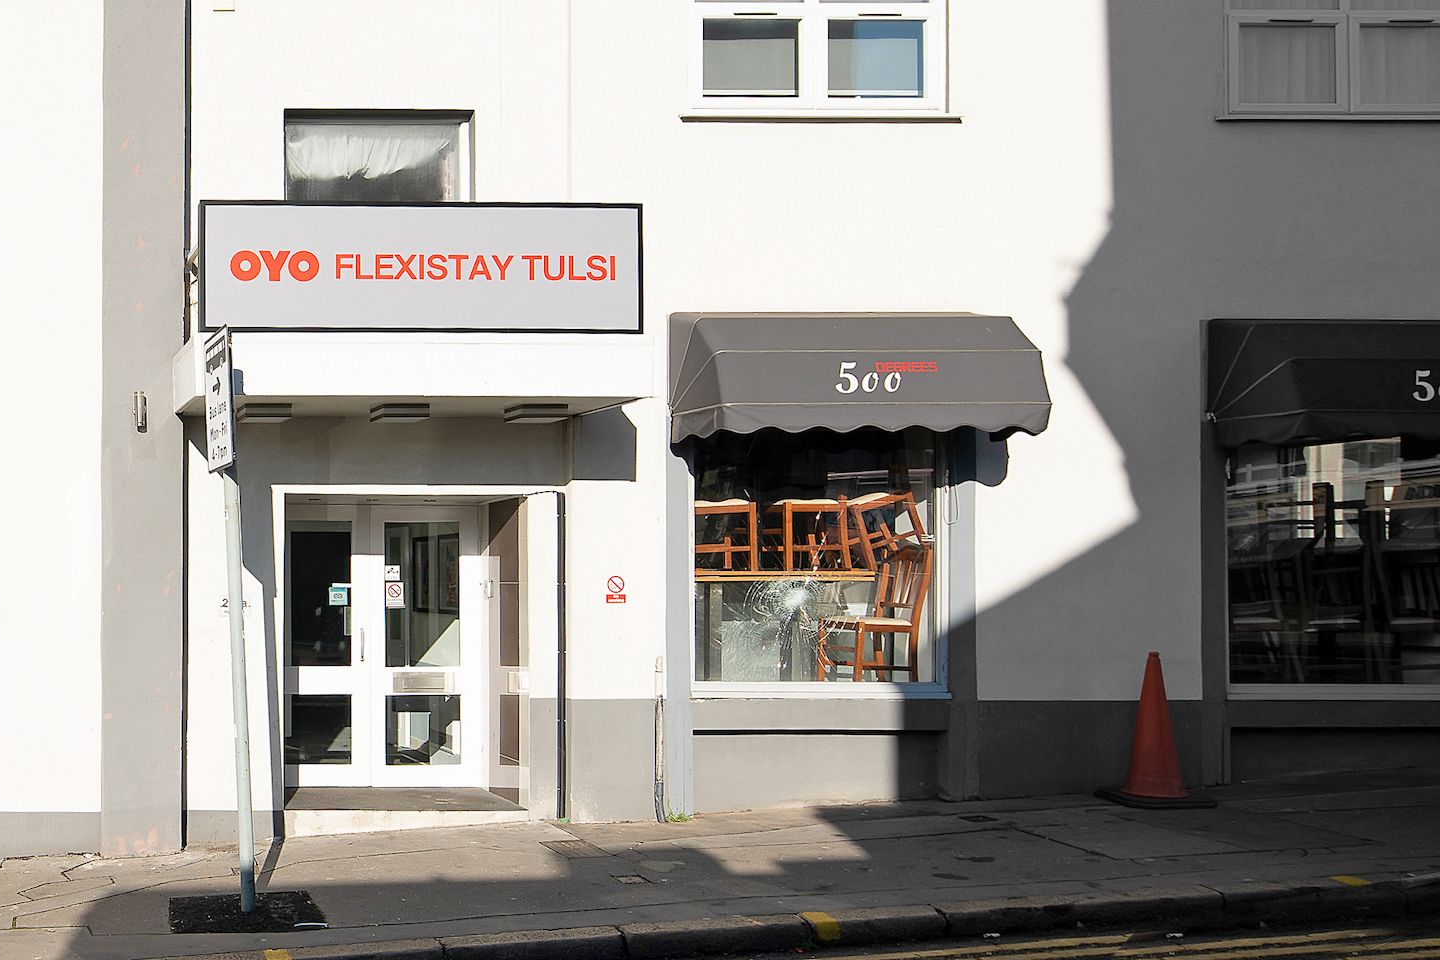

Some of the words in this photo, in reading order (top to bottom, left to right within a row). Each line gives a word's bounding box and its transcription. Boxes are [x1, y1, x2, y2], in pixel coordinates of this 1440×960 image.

[229, 250, 320, 282] OYO
[335, 253, 514, 281] FLEXISTAY
[522, 254, 617, 282] TULSI
[875, 361, 939, 373] DEGREES
